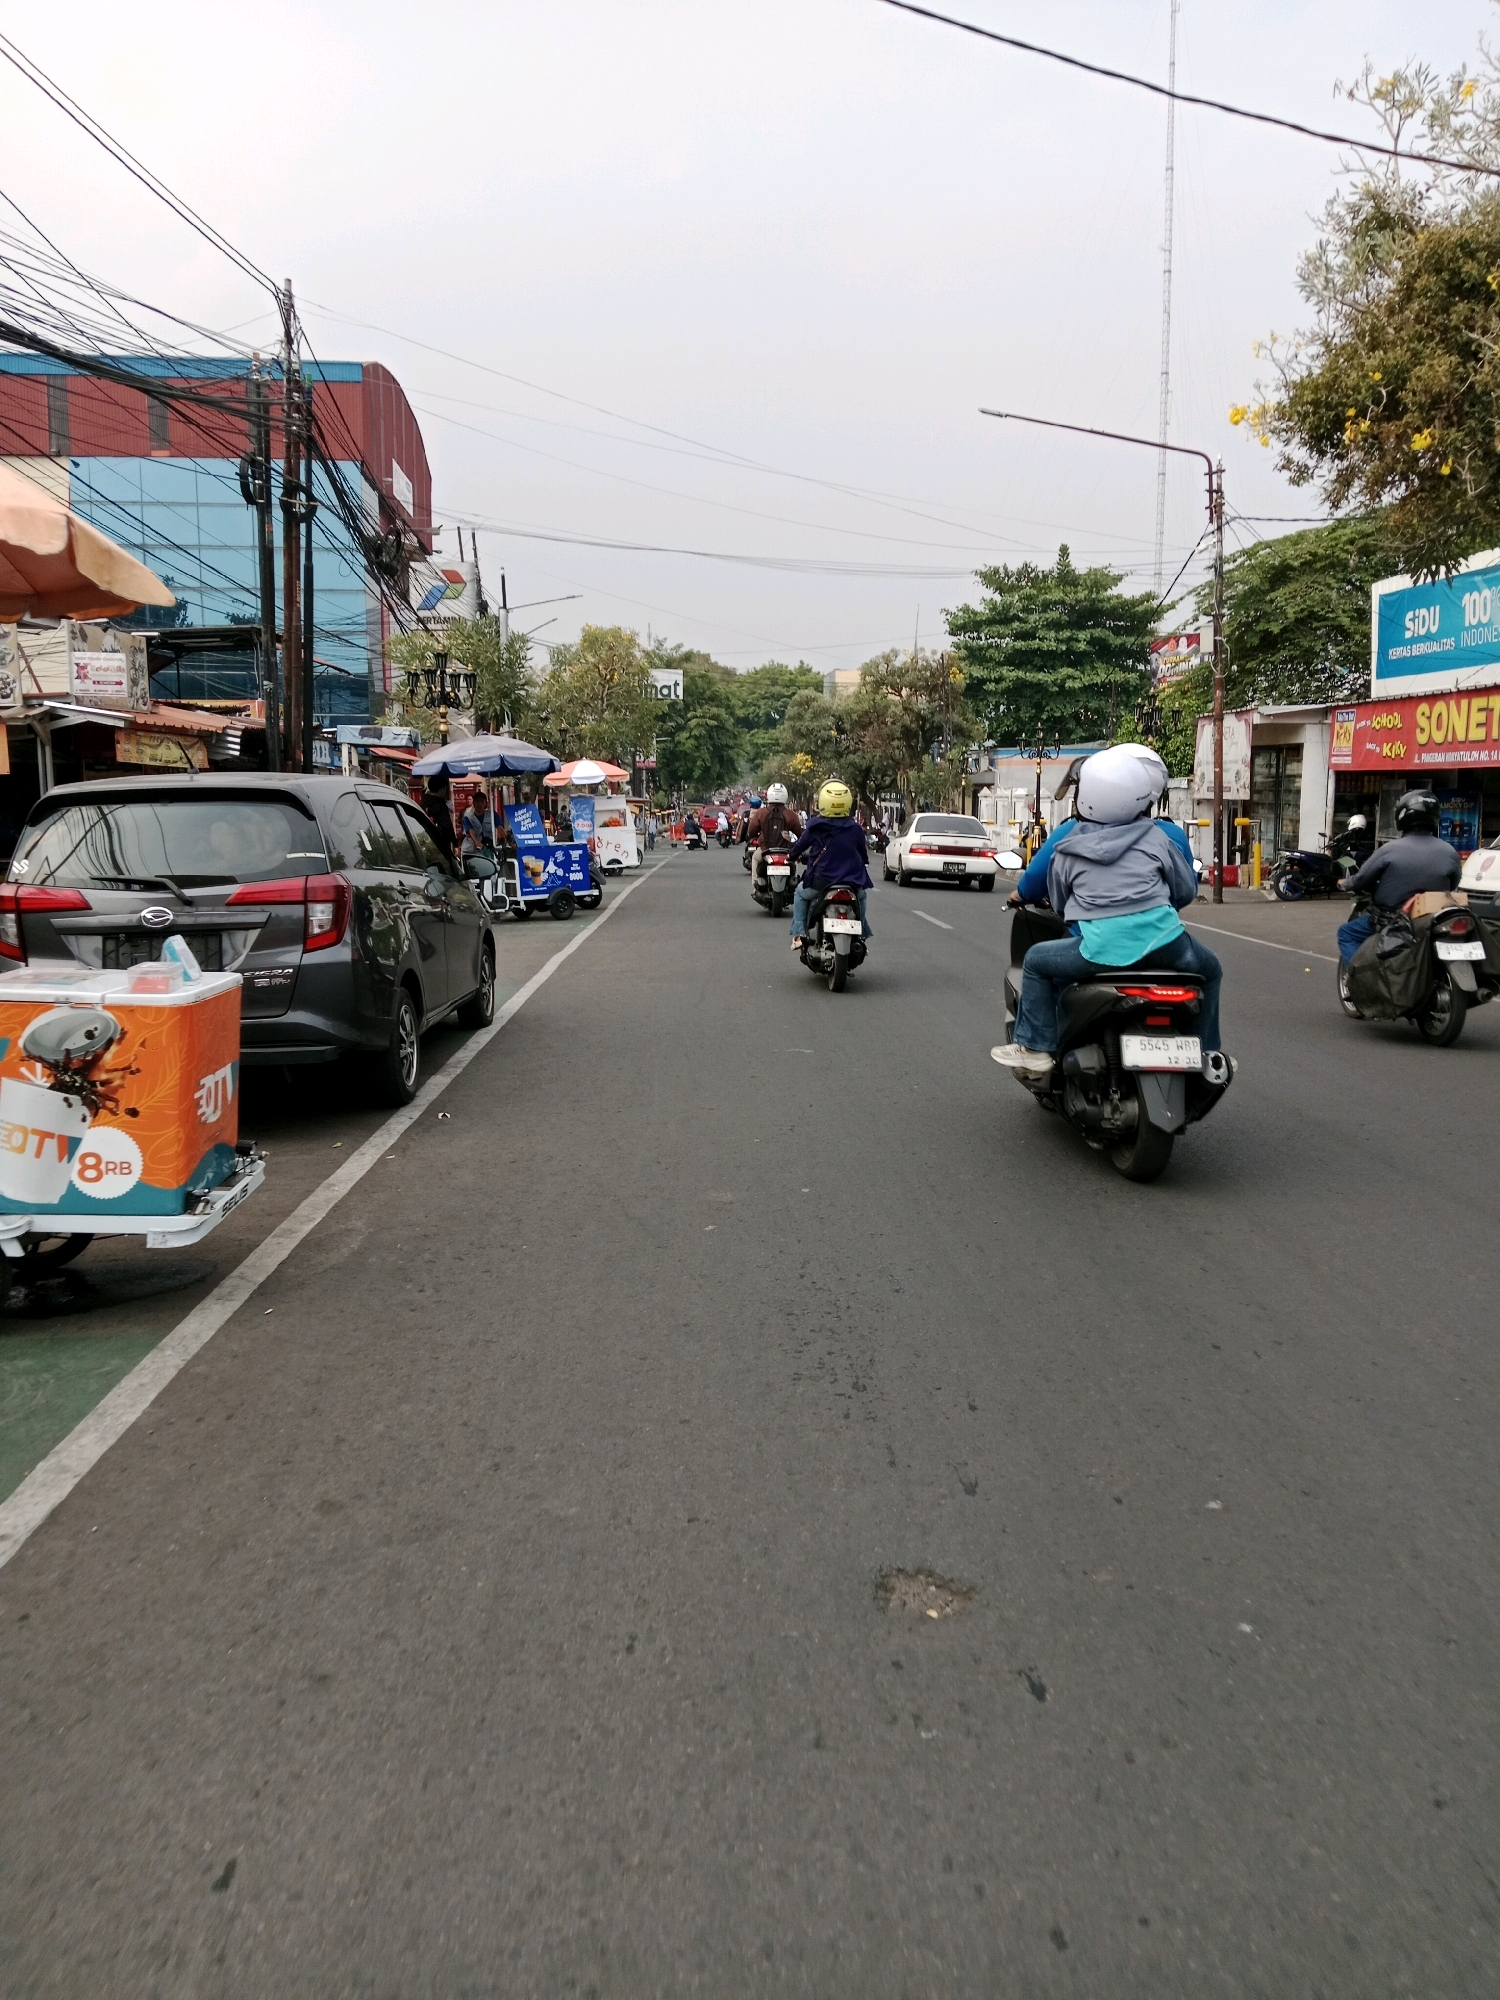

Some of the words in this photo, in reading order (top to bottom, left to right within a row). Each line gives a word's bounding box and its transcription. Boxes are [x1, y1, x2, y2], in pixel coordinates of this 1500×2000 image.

[1461, 624, 1500, 647] INDONE
[1388, 645, 1411, 660] KERTAS
[1411, 637, 1455, 656] BERKUALITAS
[1371, 712, 1403, 730] SCHOOL
[1382, 740, 1407, 759] KIKY
[1140, 1039, 1170, 1051] 5545
